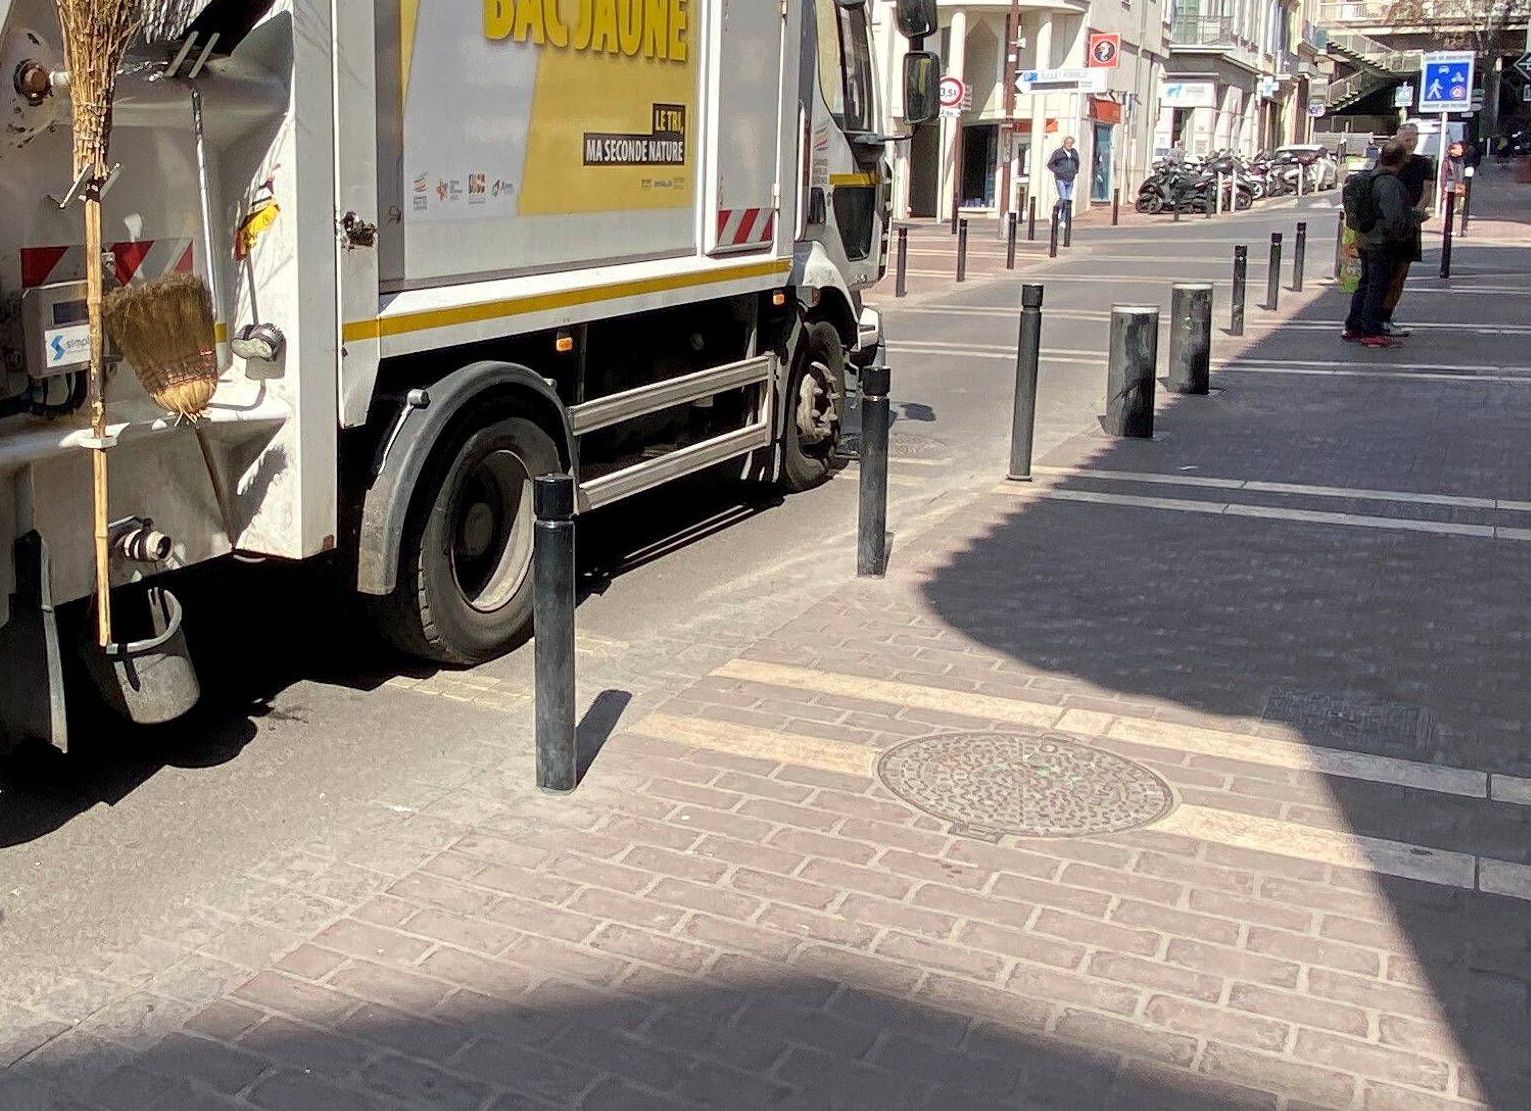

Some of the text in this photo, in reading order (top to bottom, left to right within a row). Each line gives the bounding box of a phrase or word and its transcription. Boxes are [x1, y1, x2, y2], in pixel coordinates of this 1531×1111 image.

[655, 109, 666, 131] LE
[586, 139, 683, 162] MA SECONDE NATURE
